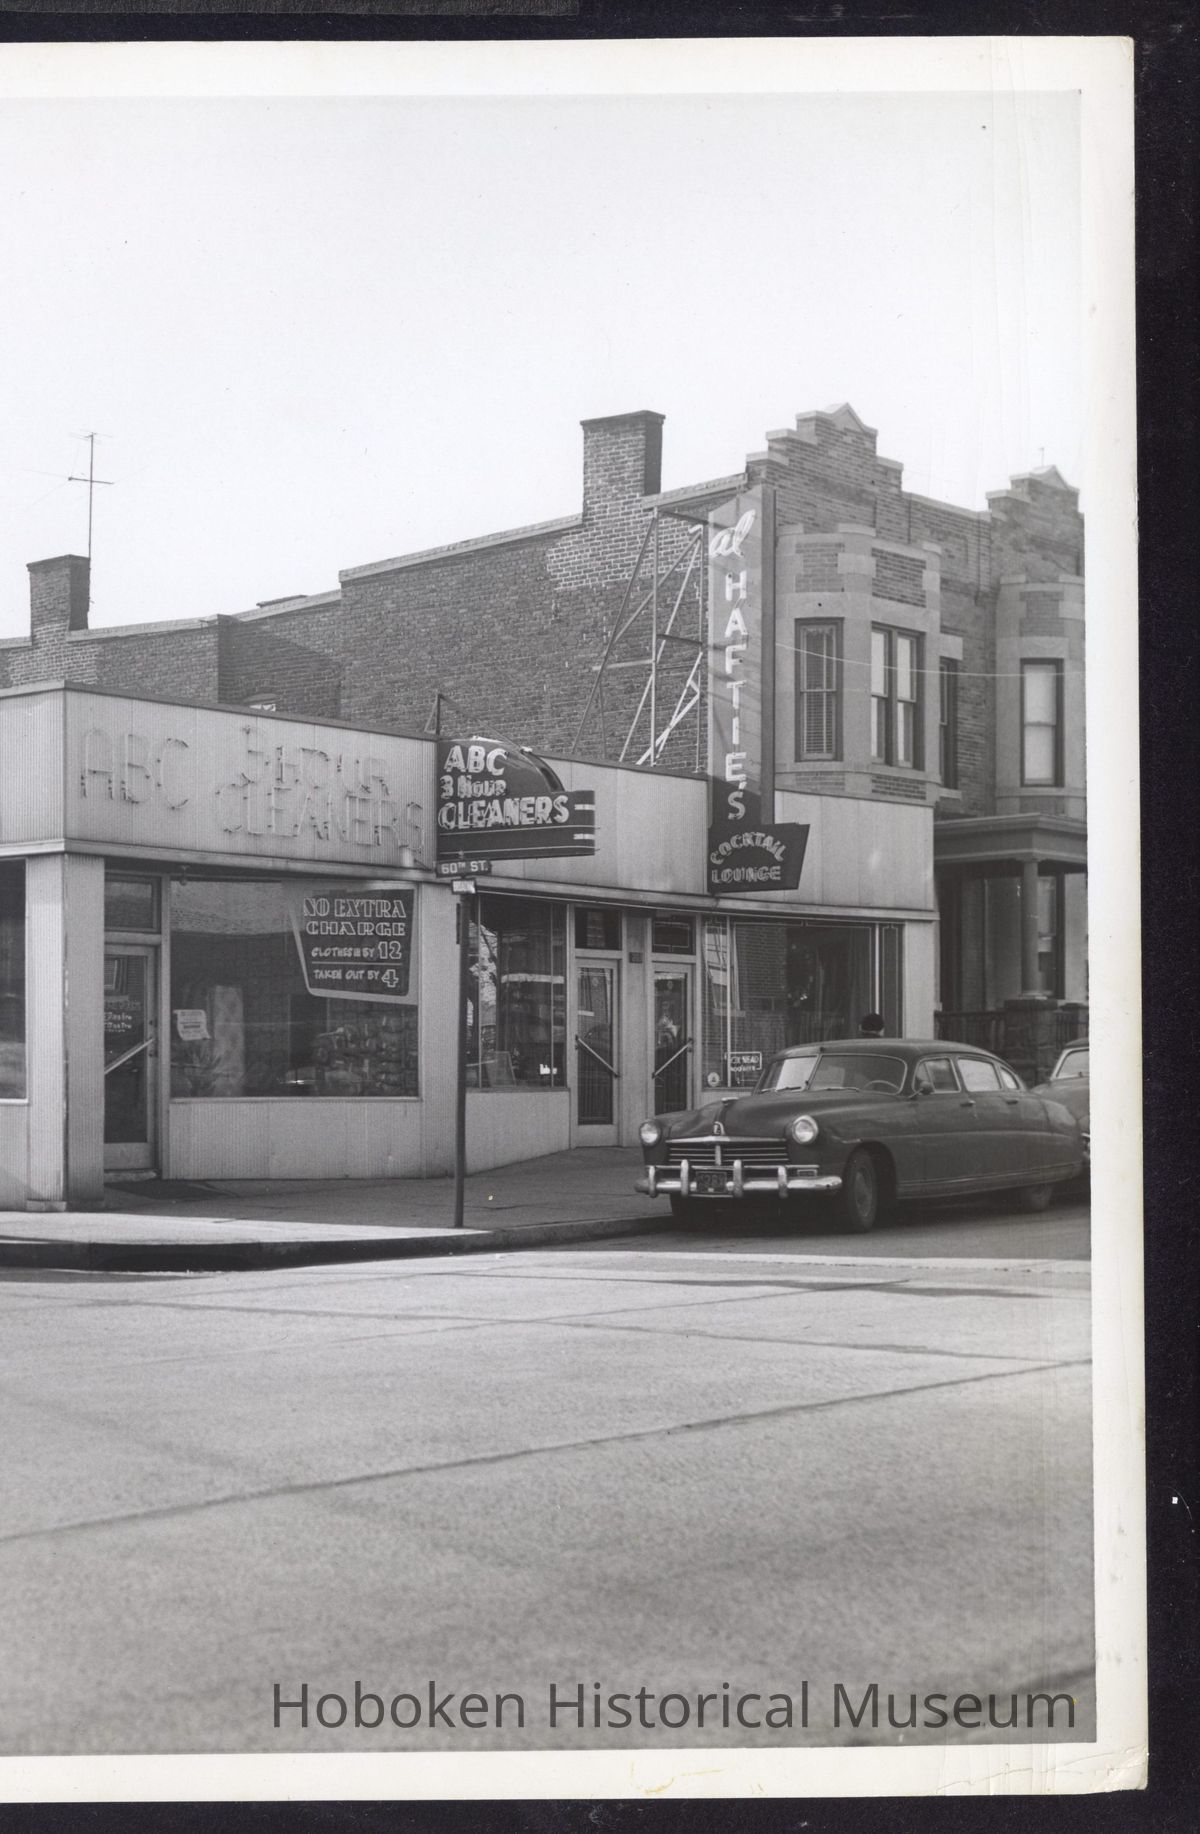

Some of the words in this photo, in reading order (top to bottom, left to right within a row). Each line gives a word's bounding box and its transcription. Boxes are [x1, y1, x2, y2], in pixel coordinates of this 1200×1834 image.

[80, 727, 190, 811] ABC
[443, 745, 507, 776] ABC
[440, 775, 454, 799] 3
[214, 782, 426, 853] CLEANERS
[438, 795, 570, 830] CLEANERS
[710, 831, 786, 864] COCKTAIL
[470, 860, 488, 872] ST.
[711, 865, 781, 883] LOUNGE
[303, 897, 330, 917] NO
[334, 899, 407, 918] EXTRA
[305, 921, 406, 936] CHARGE
[311, 947, 353, 957] CLOTHES
[378, 941, 402, 959] 12
[313, 969, 342, 979] TAKEN
[345, 970, 365, 980] OUT
[367, 970, 380, 980] BY
[381, 969, 399, 988] 4
